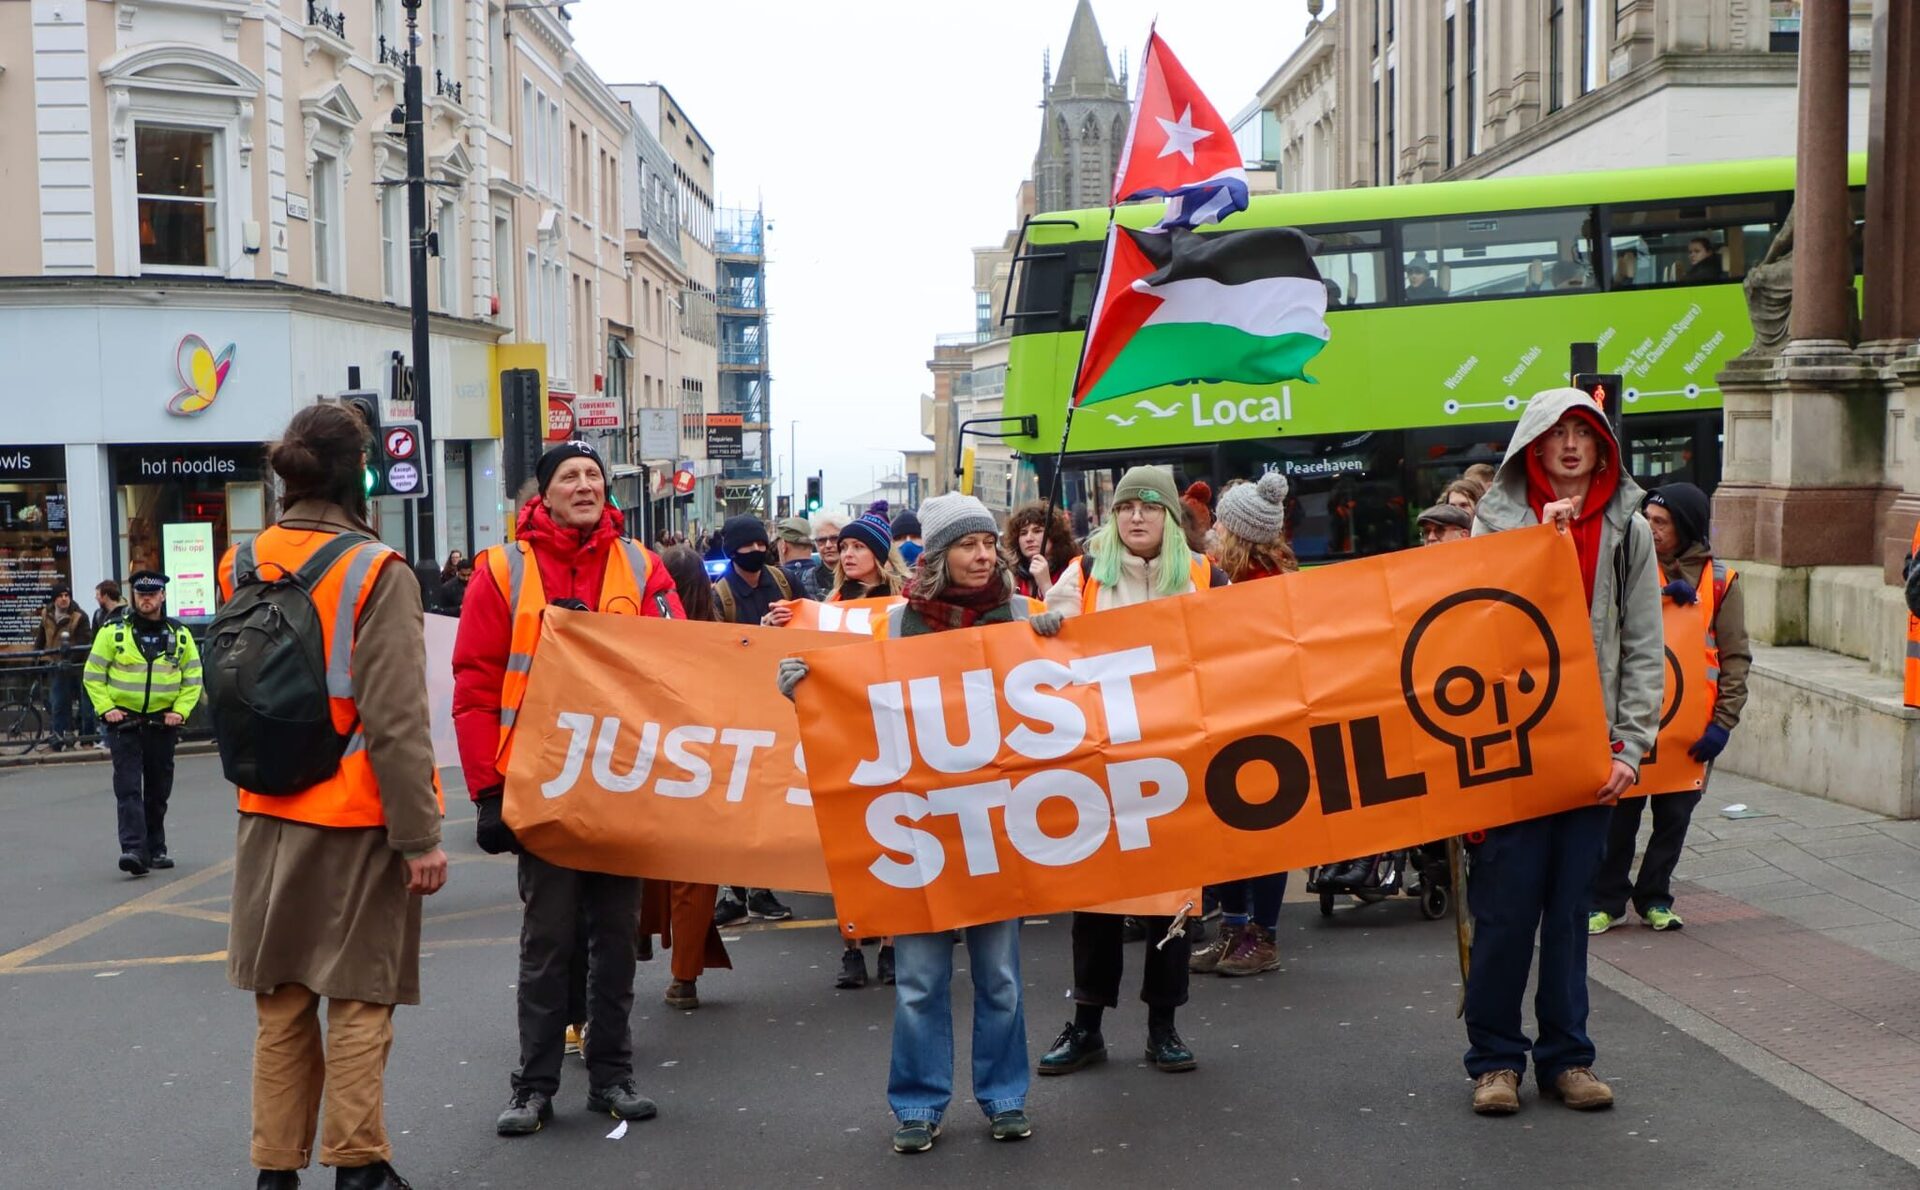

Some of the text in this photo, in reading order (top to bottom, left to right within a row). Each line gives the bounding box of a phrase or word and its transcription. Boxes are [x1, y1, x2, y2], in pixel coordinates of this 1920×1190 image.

[1630, 336, 1654, 359] Tower
[1632, 303, 1702, 378] (for Churchill Square)
[1682, 330, 1725, 375] North Street
[1443, 354, 1479, 390] Westdene
[1501, 345, 1542, 387] Seven Dials
[549, 415, 572, 423] CKEN
[581, 417, 616, 426] OFF LICENCE
[723, 416, 738, 424] SALE
[1191, 385, 1292, 427] Local
[0, 451, 31, 469] wls
[141, 456, 236, 475] hot noodles
[1285, 458, 1364, 475] Peacehaven
[850, 645, 1157, 786] JUST
[541, 712, 775, 801] JUST
[865, 757, 1188, 889] STOP
[1205, 716, 1427, 831] OIL
